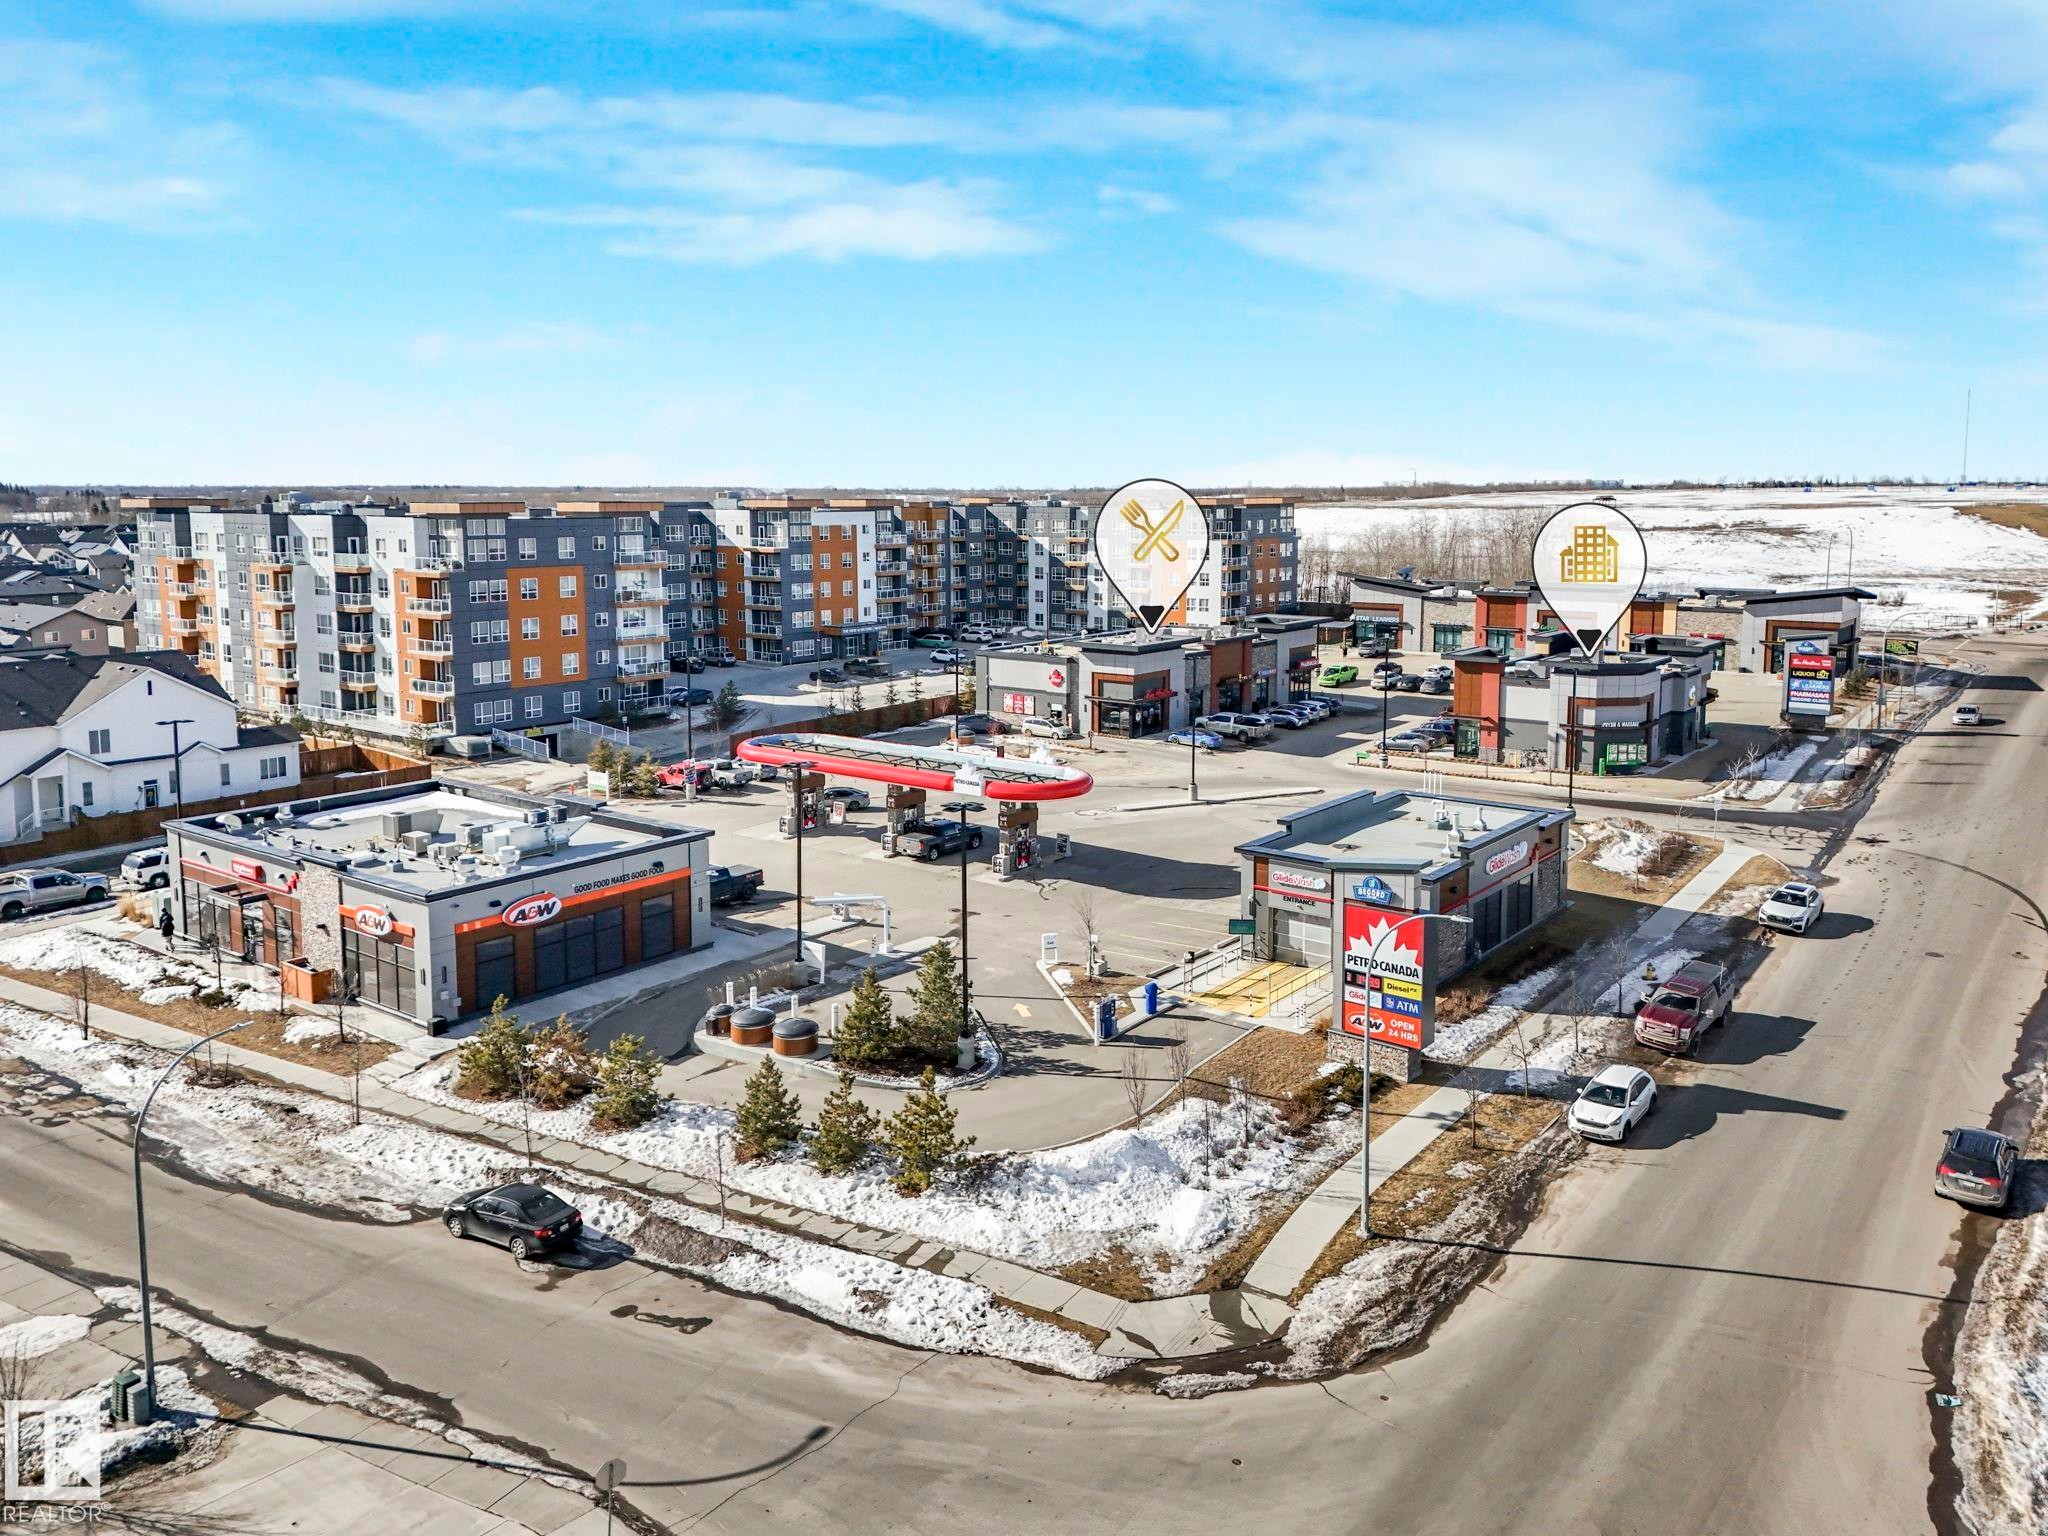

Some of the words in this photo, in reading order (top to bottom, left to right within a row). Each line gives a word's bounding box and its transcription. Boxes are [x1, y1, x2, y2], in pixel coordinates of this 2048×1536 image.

[1489, 844, 1521, 873] GlideWash
[574, 882, 592, 893] GOOD
[593, 878, 610, 890] FOOD
[611, 873, 630, 885] MAKES
[631, 869, 648, 880] GOOD
[648, 865, 665, 876] FOOD
[1272, 872, 1315, 889] GlideWash
[1283, 895, 1316, 907] ENTRANCE
[512, 899, 558, 924] A&W
[359, 913, 386, 932] A&W
[1386, 982, 1410, 994] Diesel
[1396, 1000, 1419, 1014] ATM
[1390, 1019, 1415, 1031] OPEN
[1388, 1029, 1399, 1038] 24
[1400, 1031, 1419, 1042] HRS
